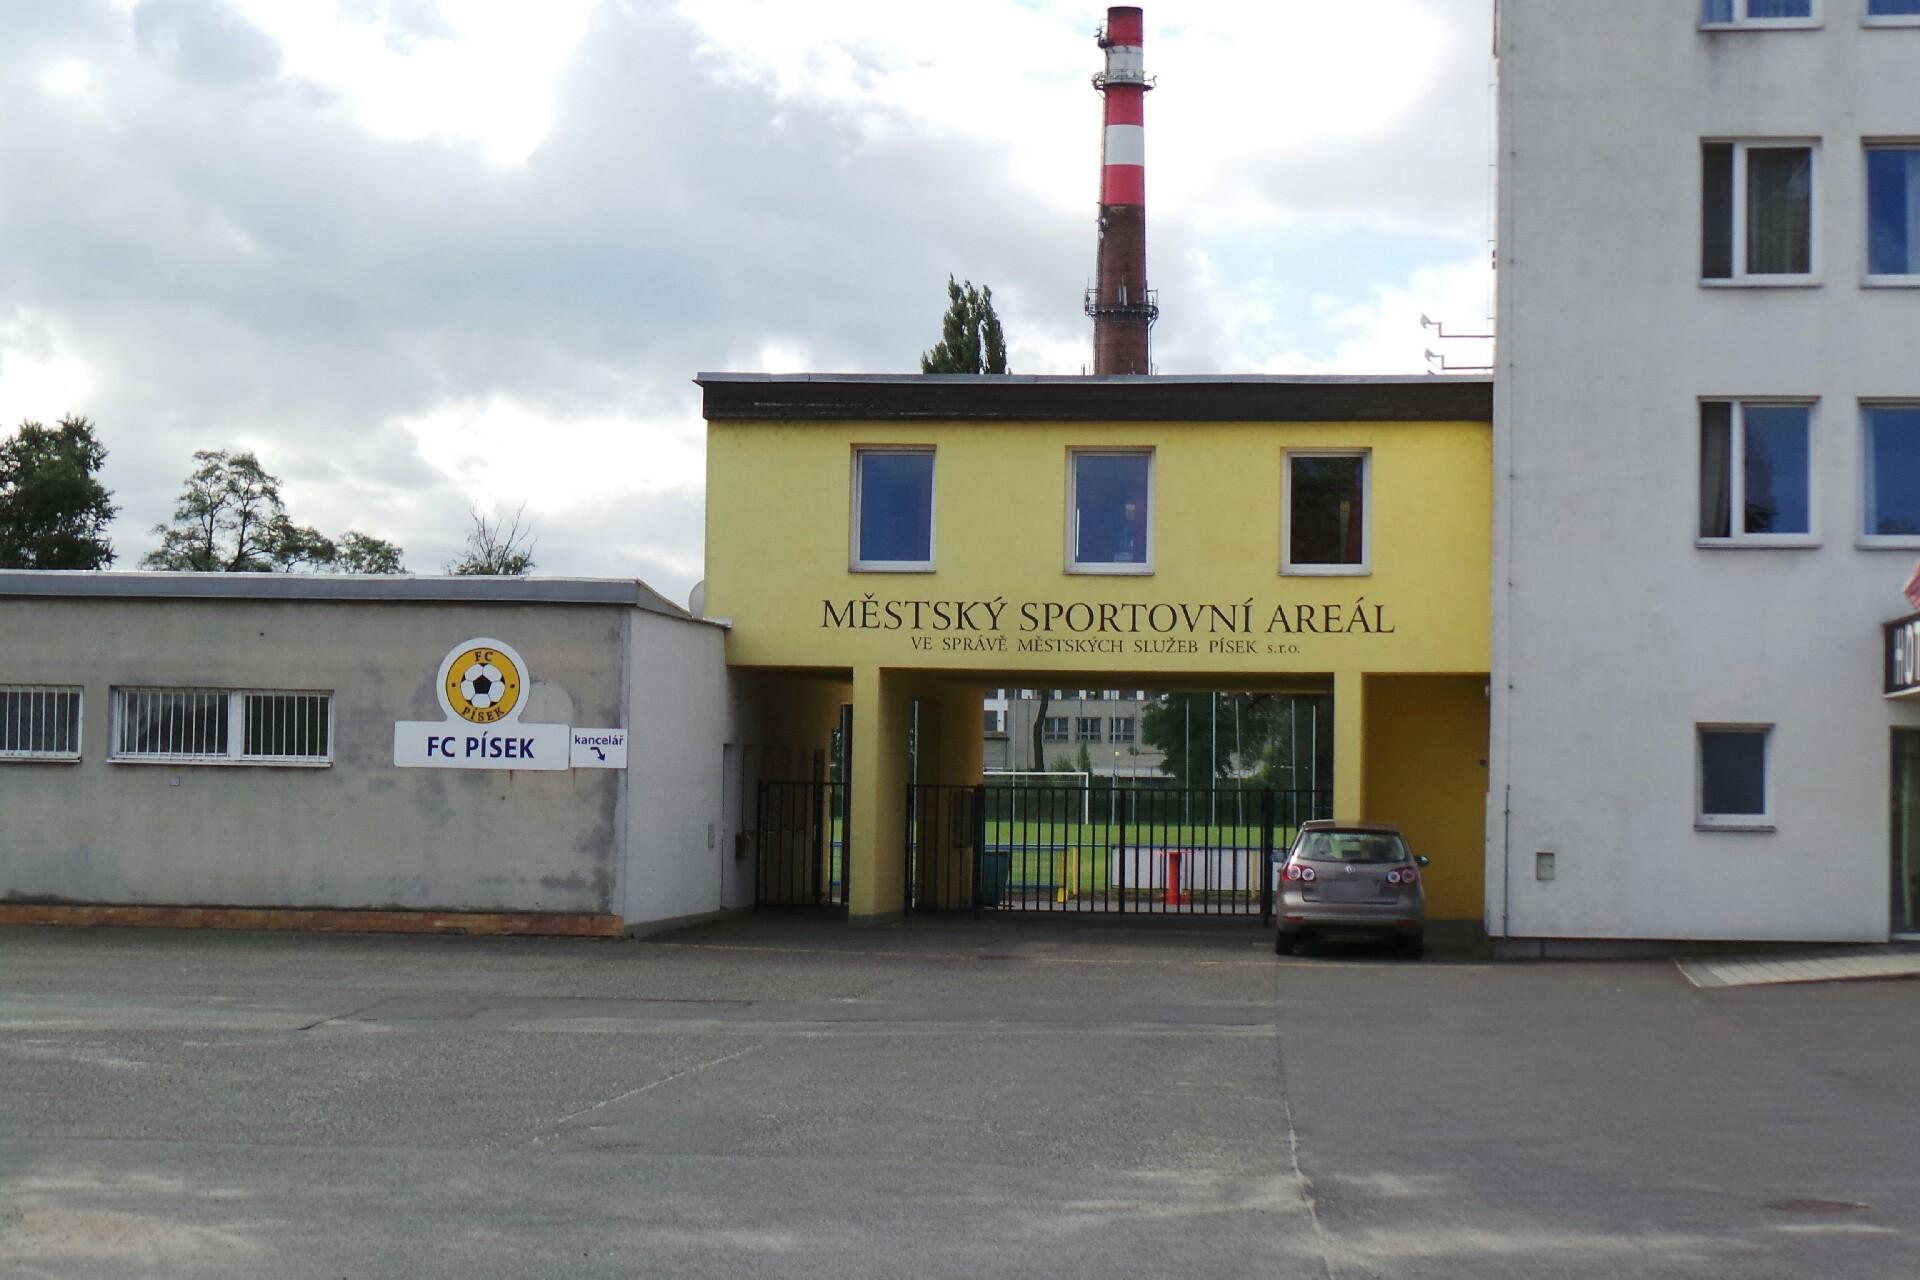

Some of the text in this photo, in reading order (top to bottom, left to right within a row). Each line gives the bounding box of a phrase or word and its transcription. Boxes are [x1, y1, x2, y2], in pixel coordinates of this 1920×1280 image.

[820, 592, 1396, 634] MĚSTSKÝ SPORTOVNÍ AREÁL
[911, 634, 1300, 654] VE SPRÁVĚ MĚSTSKÝCH SLUŽEB PÍSEK s.r.o.
[475, 651, 493, 662] FC
[461, 706, 505, 721] PÍSEK
[427, 731, 535, 759] FC PÍSEK
[574, 735, 624, 745] kancelář
